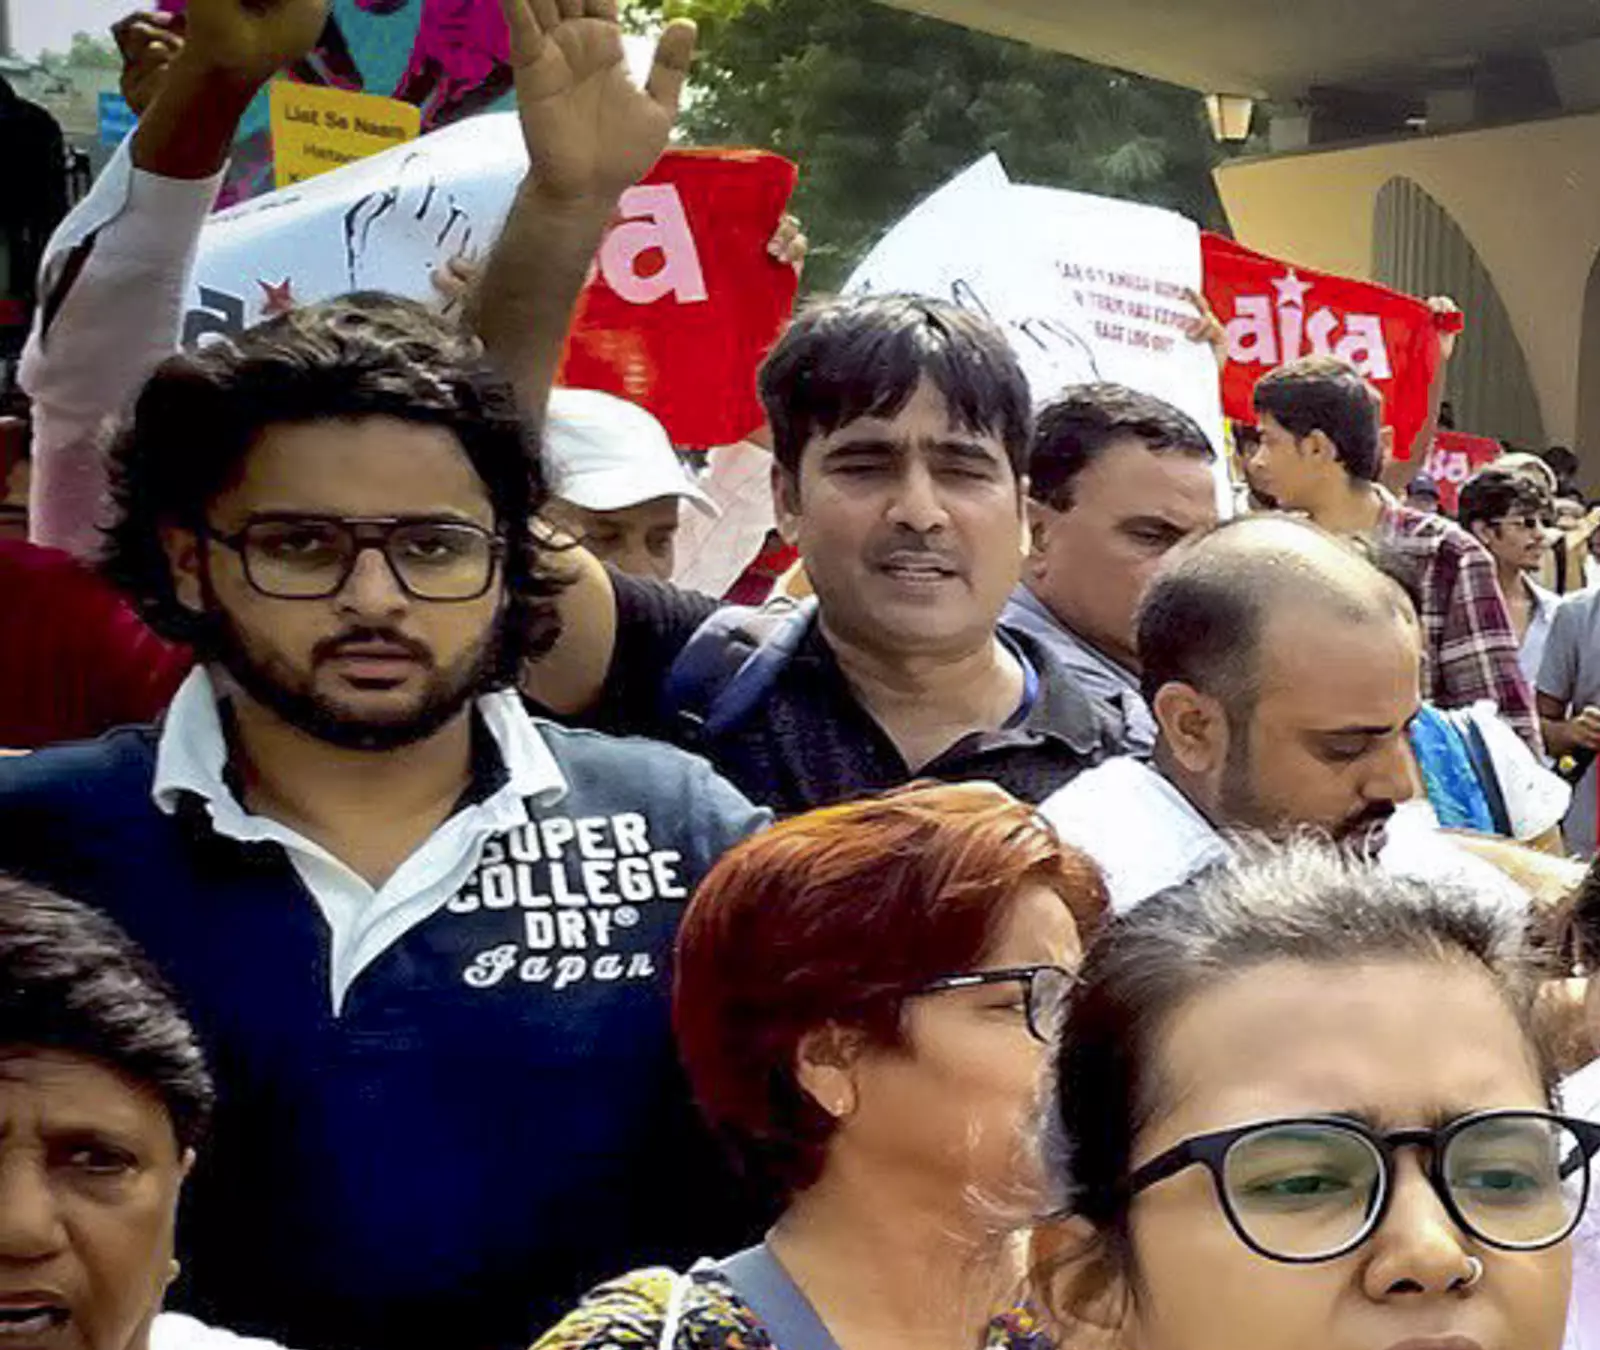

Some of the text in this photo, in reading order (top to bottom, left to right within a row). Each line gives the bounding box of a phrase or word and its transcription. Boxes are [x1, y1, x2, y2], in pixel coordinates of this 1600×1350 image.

[482, 812, 650, 864] SUPER
[446, 851, 687, 912] COLLEGE
[463, 944, 655, 990] Japan
